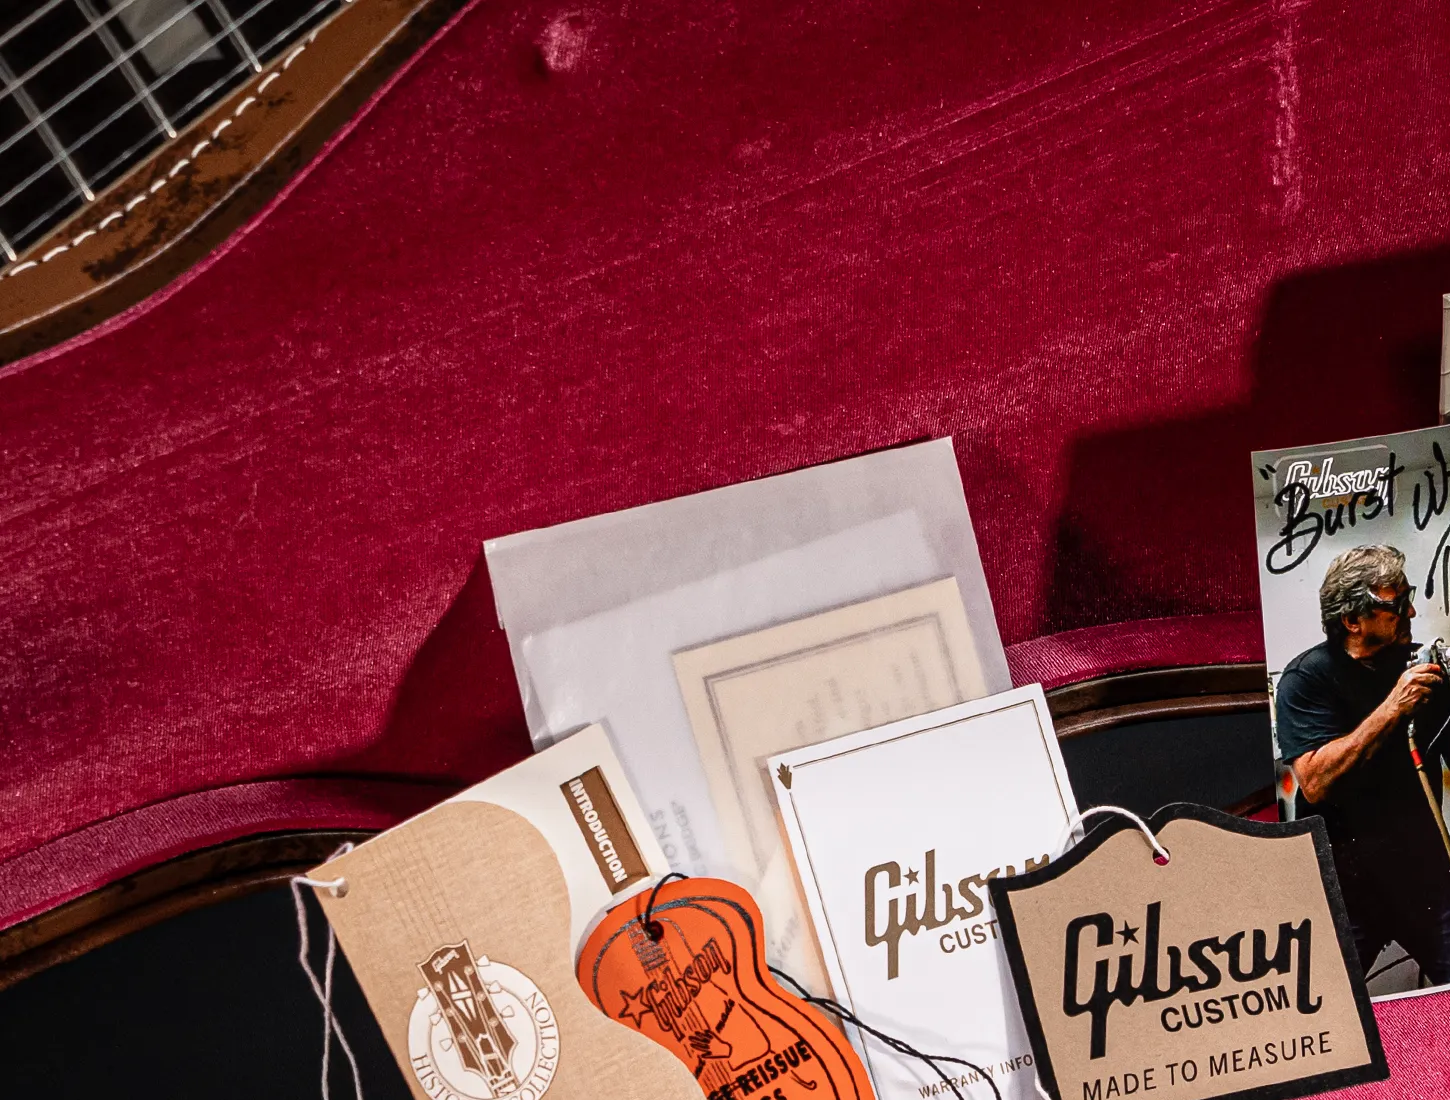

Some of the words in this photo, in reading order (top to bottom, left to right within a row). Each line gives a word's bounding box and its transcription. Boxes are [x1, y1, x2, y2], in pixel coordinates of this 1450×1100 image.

[567, 778, 629, 885] INTRODUCTION
[939, 919, 998, 954] CUST
[646, 936, 732, 1043] Gibson
[1064, 900, 1324, 1060] Gibson
[1161, 984, 1291, 1033] CUSTOM
[735, 1038, 813, 1097] REISSUE
[918, 1064, 995, 1099] WARRANTY
[1169, 1061, 1198, 1088] TO
[1208, 1031, 1333, 1075] MEASURE
